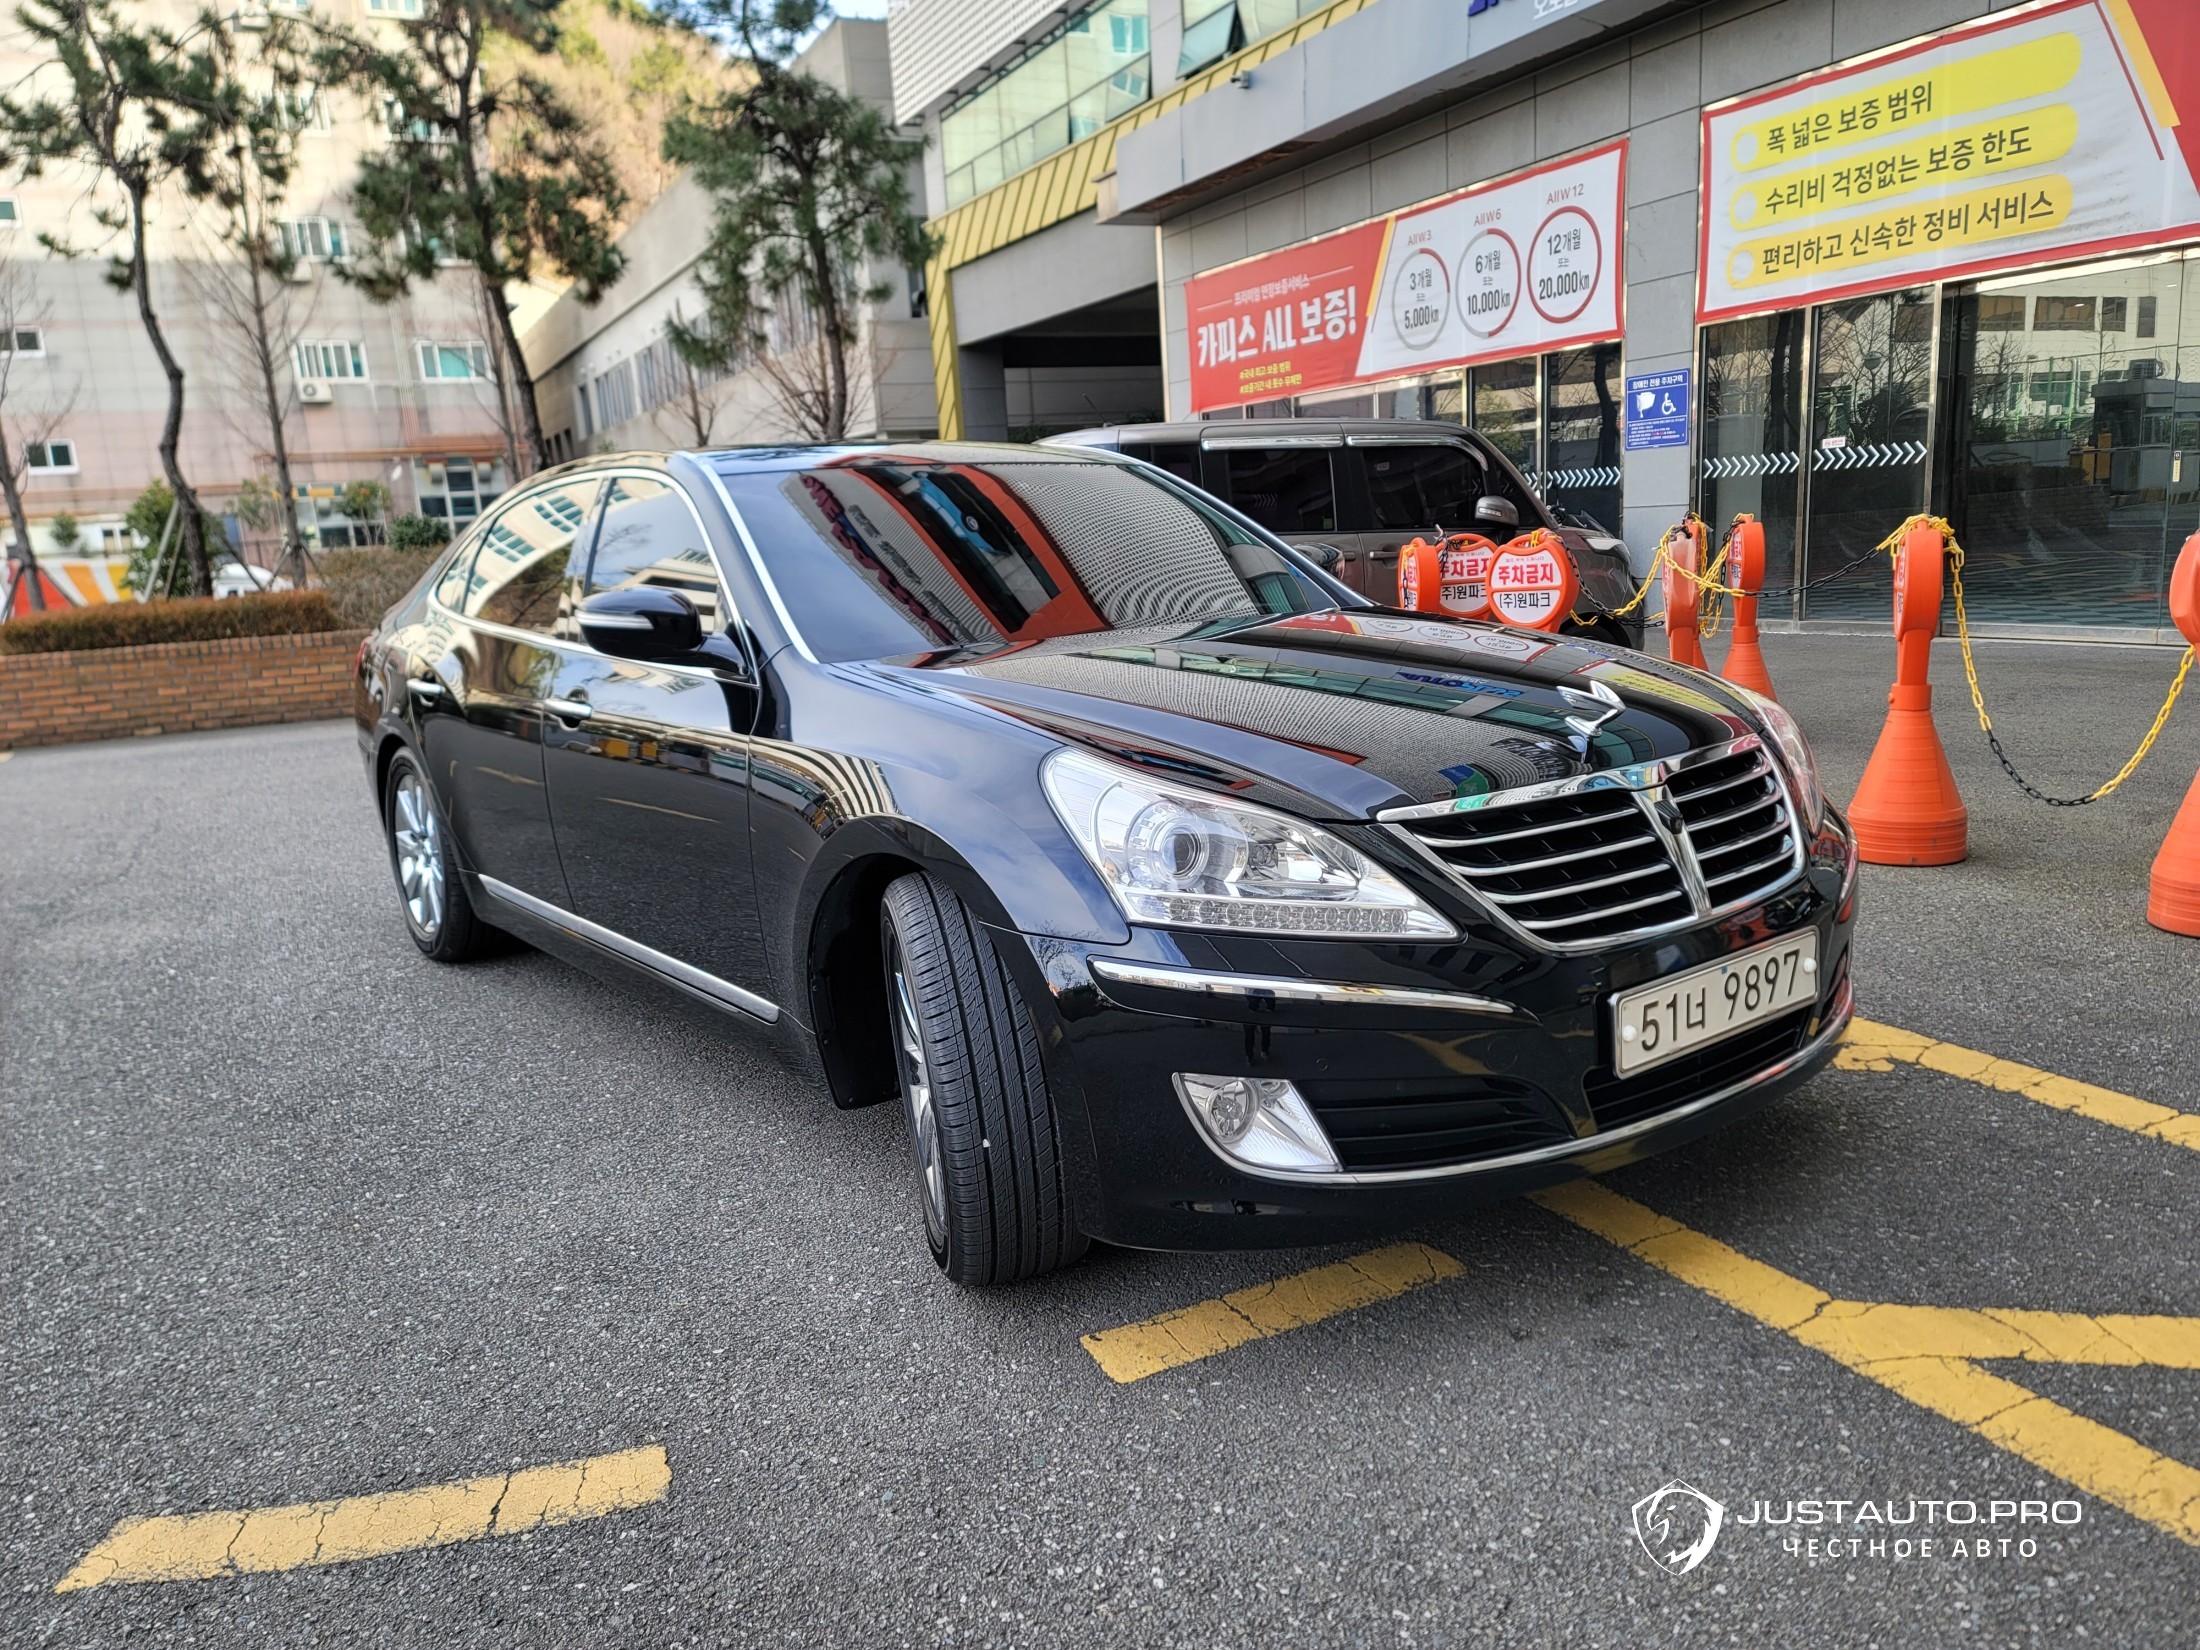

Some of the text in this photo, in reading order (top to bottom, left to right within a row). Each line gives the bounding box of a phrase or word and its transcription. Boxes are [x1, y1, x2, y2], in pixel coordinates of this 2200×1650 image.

[1766, 80, 1933, 154] 폭 넓은 보증 범위
[1765, 125, 2032, 215] 수리비 걱정없는 보증 한도
[1762, 189, 2055, 275] 편리하고 신속한 정비 서비스
[1197, 285, 1356, 368] 카피스 ALL 보증!
[1441, 584, 1487, 601] 주)원파
[1498, 563, 1554, 585] 주차금지
[1500, 592, 1551, 609] (주)원파크
[1641, 949, 1801, 1051] 51너 9897
